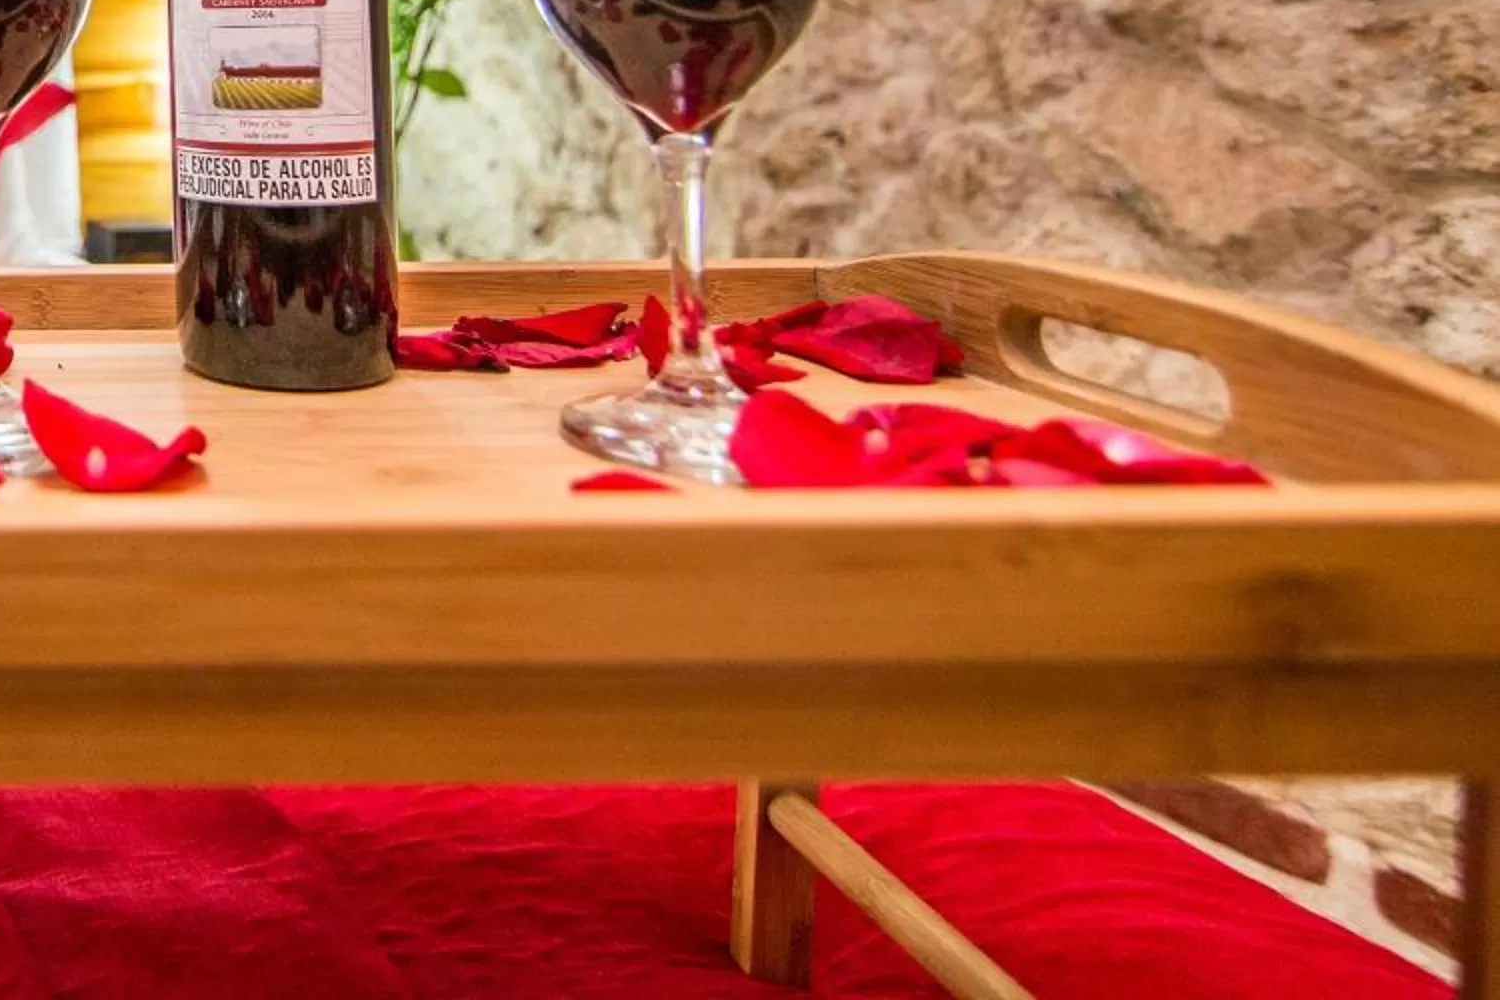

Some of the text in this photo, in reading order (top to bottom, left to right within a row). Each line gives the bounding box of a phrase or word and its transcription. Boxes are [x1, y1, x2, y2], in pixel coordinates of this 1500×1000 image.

[179, 153, 372, 179] EL EXCESO DE ALCOHOL ES
[179, 173, 373, 200] PERJUDICIAL PARA LA SALUD
